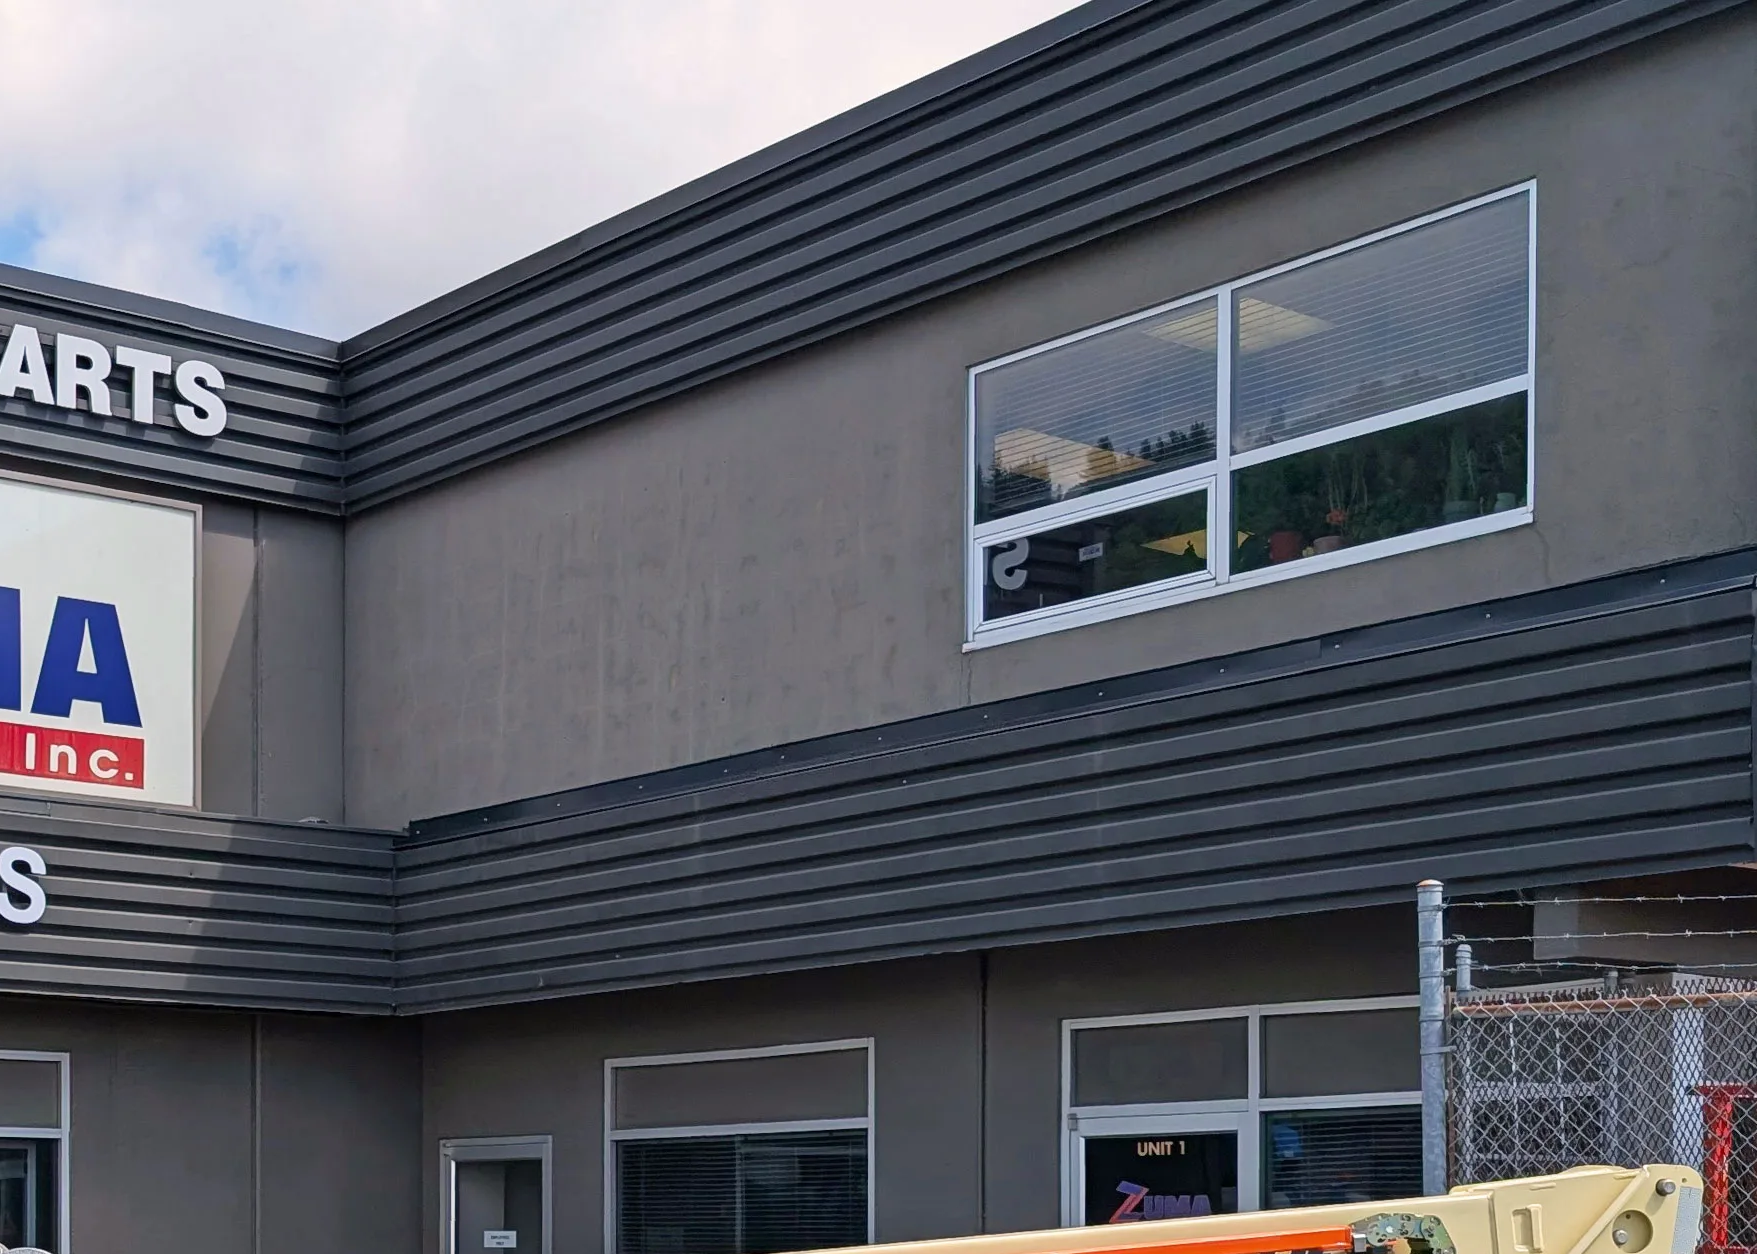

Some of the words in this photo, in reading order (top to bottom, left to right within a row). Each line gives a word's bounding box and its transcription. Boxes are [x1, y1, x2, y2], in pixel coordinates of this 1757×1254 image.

[25, 732, 134, 782] Inc.
[1137, 1141, 1174, 1156] UNIT
[1179, 1140, 1186, 1155] 1
[1109, 1180, 1212, 1224] ZUMA
